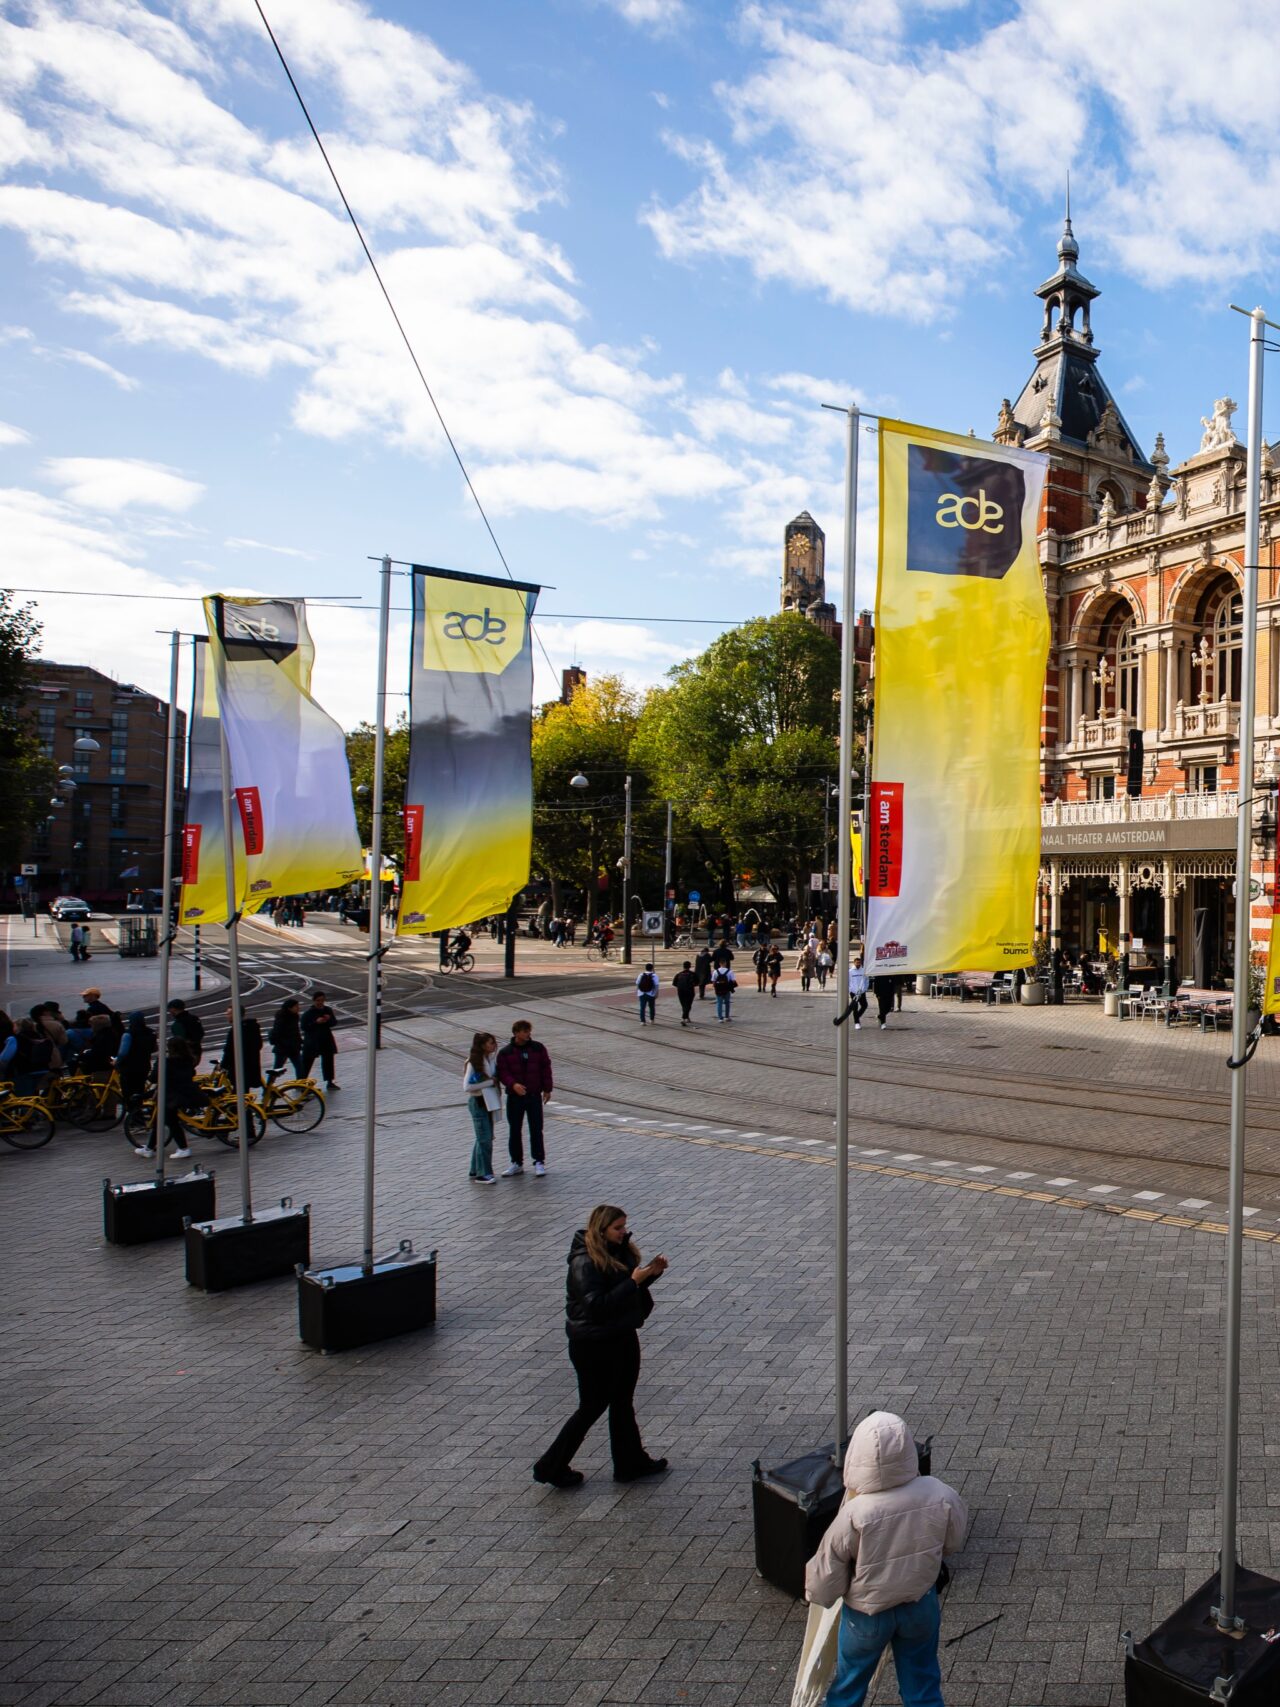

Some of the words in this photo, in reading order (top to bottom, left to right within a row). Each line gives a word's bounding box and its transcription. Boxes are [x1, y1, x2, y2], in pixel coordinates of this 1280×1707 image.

[935, 489, 1004, 534] ade
[443, 608, 507, 645] ade
[1067, 832, 1103, 845] THEATER
[1105, 830, 1165, 844] AMSTERDAM
